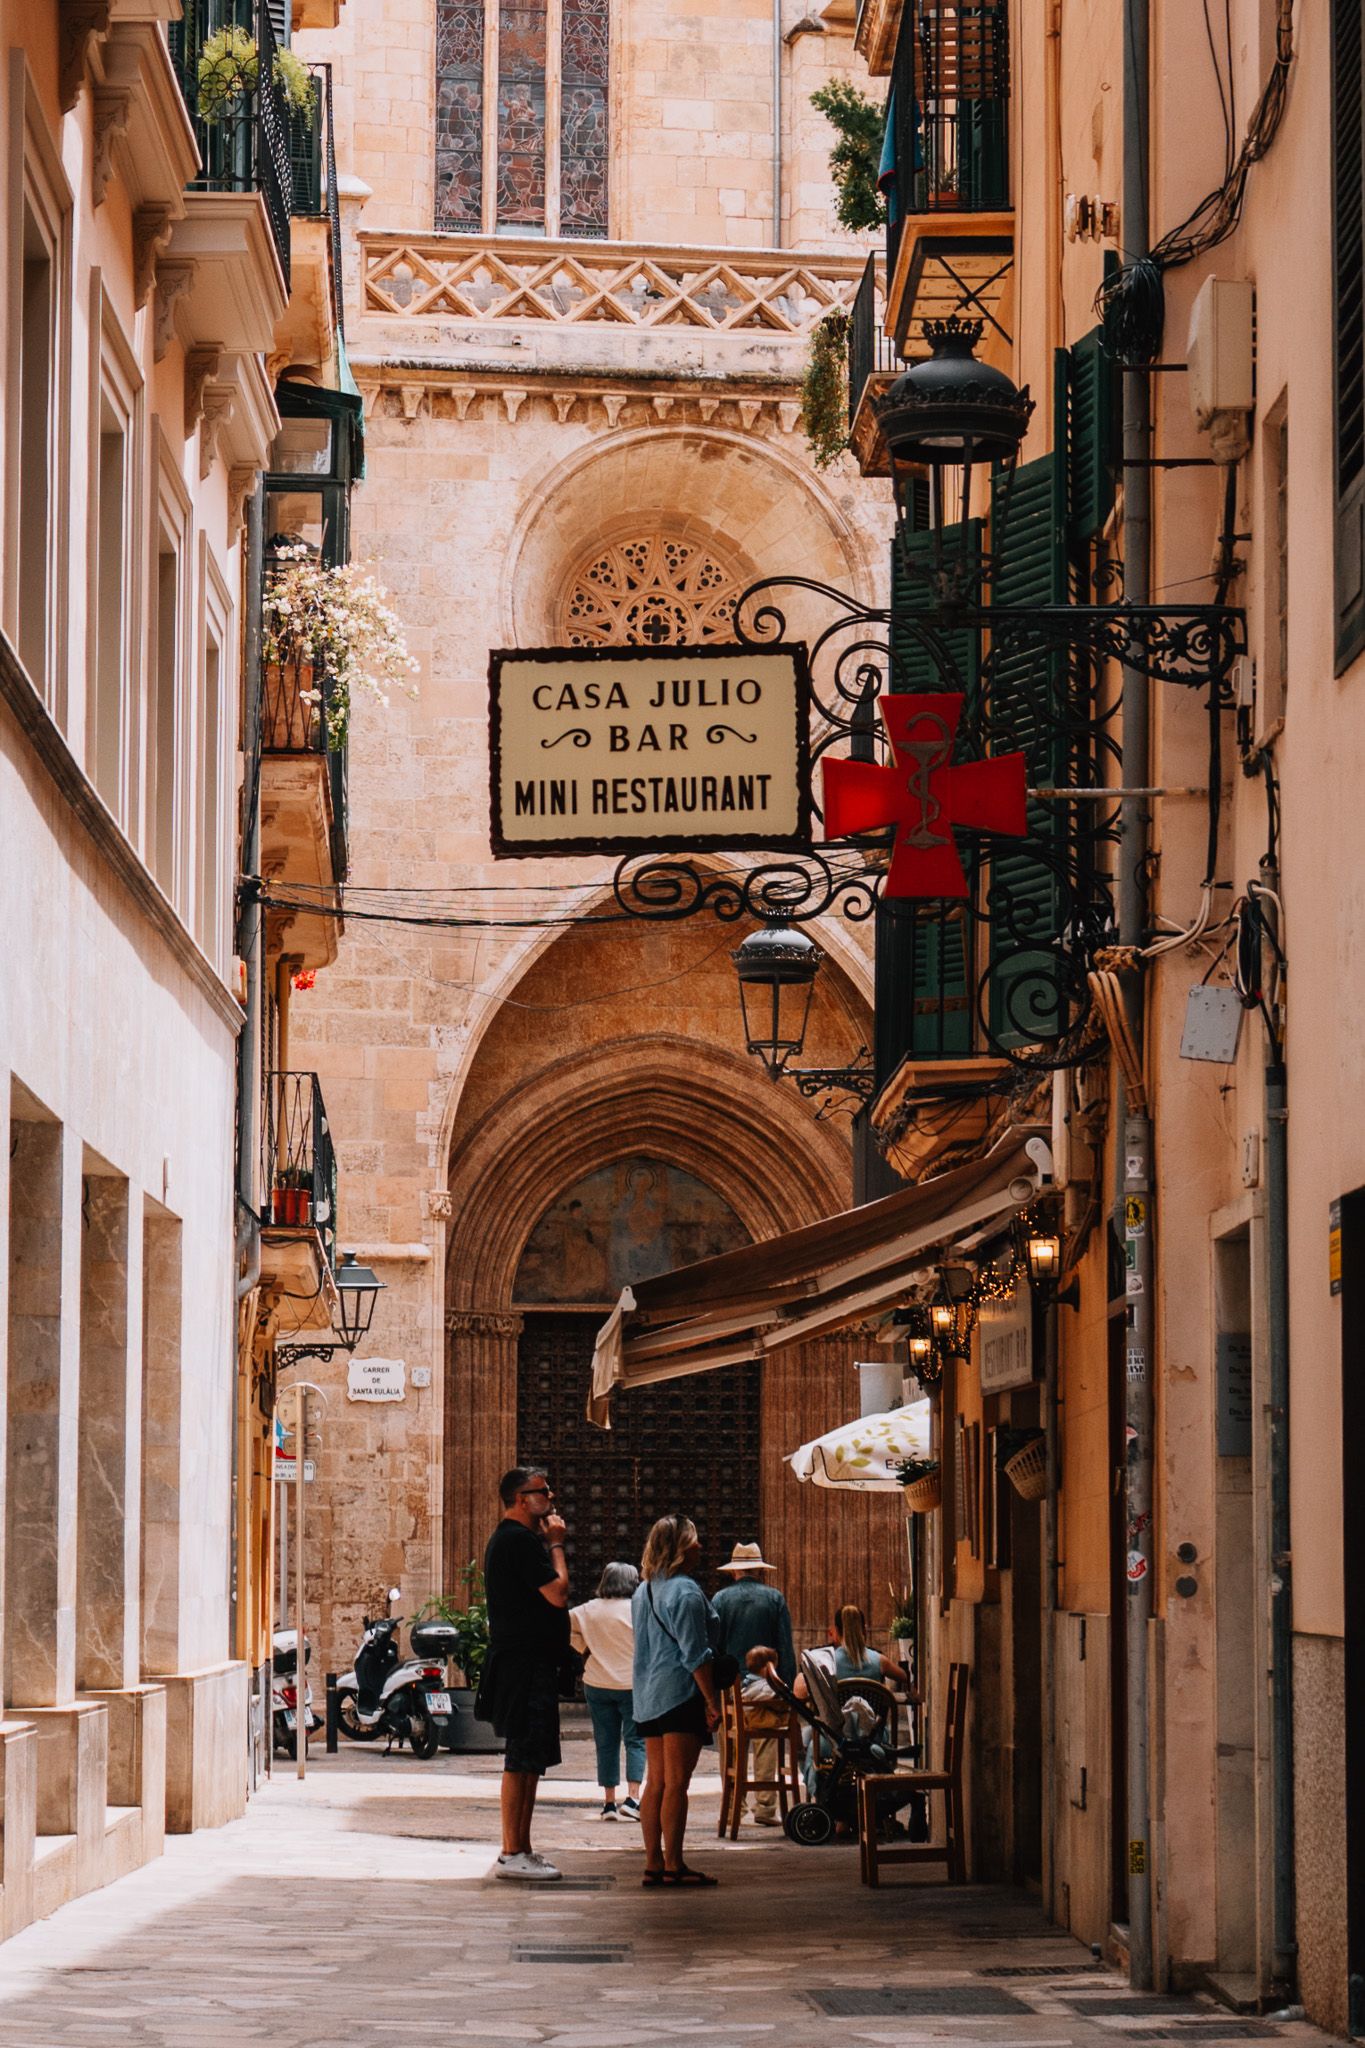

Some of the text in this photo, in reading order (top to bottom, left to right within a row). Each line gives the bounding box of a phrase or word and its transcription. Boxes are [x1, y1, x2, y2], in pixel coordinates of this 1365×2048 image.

[533, 679, 762, 711] CASA JULIO
[609, 724, 689, 752] BAR
[515, 774, 772, 816] MINI RESTAURANT
[417, 1372, 425, 1382] 2
